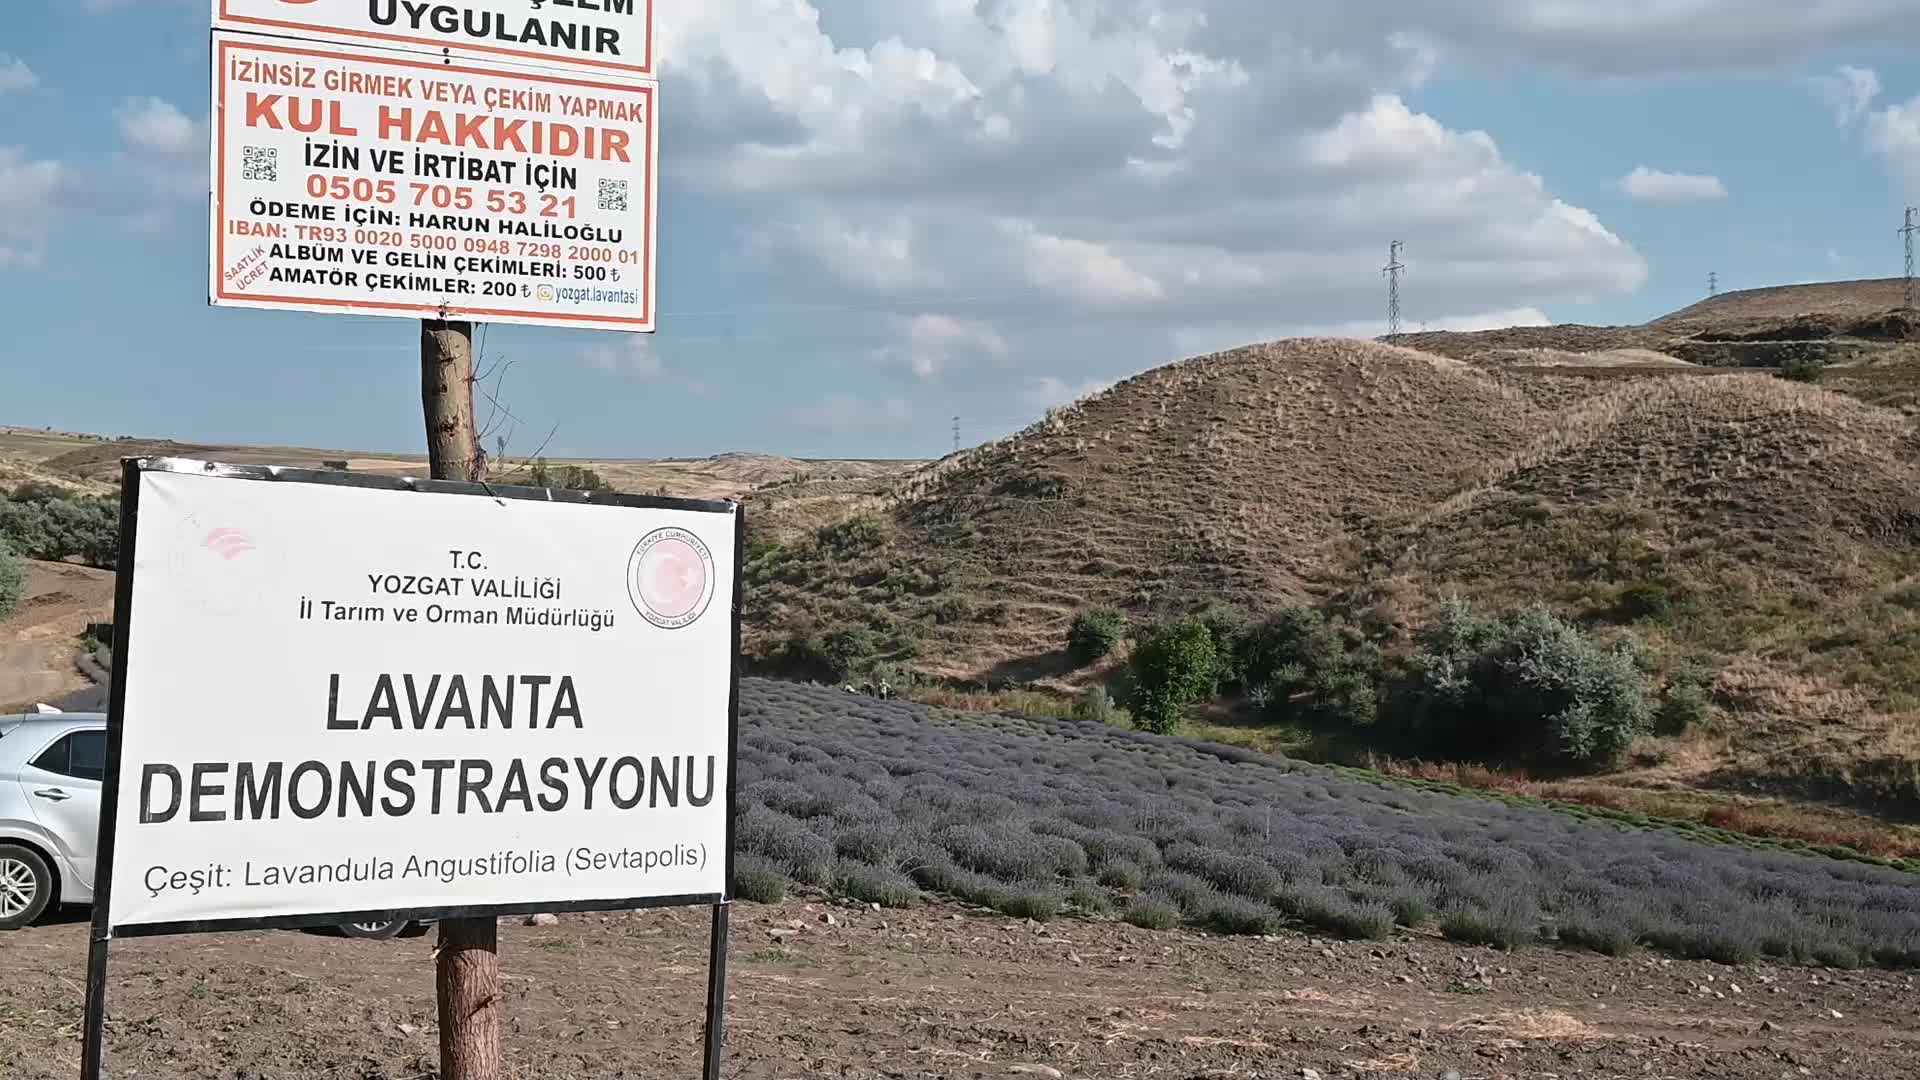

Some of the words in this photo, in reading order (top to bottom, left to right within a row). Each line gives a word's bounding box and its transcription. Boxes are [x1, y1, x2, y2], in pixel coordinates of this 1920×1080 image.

[369, 0, 620, 55] UYGULANIR
[232, 55, 315, 88] İZİNSİZ
[324, 67, 412, 98] GİRMEK
[420, 80, 476, 105] VEYA
[485, 87, 550, 113] ÇEKİM
[559, 95, 642, 123] YAPMAK
[246, 92, 357, 136] KUL
[379, 105, 630, 162] HAKKIDIR
[305, 137, 359, 170] İZİN
[370, 149, 404, 174] VE
[415, 147, 516, 184] İRTİBAT
[526, 157, 576, 193] İÇİN
[307, 174, 395, 203] 0505
[410, 183, 472, 209] 705
[487, 190, 526, 214] 53
[540, 195, 575, 218] 21
[230, 220, 286, 238] IBAN:
[295, 225, 346, 245] TR93
[355, 230, 402, 246] 0020
[411, 234, 456, 250] 5000
[464, 238, 509, 254] 0948
[517, 242, 561, 258] 7298
[569, 246, 611, 262] 2000
[619, 250, 636, 264] 01
[250, 197, 335, 221] ÖDEME
[345, 204, 400, 227] İÇİN:
[410, 213, 489, 232] HARUN
[499, 220, 622, 243] HALİLOĞLU
[269, 243, 343, 262] ALBÜM
[351, 249, 377, 265] VE
[386, 251, 446, 269] GELİN
[454, 256, 566, 278] ÇEKİMLERİ:
[574, 265, 605, 281] 500
[269, 267, 358, 286] AMATÖR
[366, 273, 475, 294] ÇEKİMLER:
[482, 281, 516, 296] 200
[556, 286, 638, 305] yozgat.lavantasi
[449, 550, 487, 569] T.C.
[368, 574, 464, 596] YOZGAT
[471, 576, 560, 599] VALİLİĞİ
[321, 601, 384, 621] Tarım
[393, 608, 417, 622] ve
[426, 604, 497, 624] Orman
[507, 607, 614, 631] Müdürlüğü
[327, 674, 583, 730] LAVANTA
[139, 756, 715, 824] DEMONSTRASYONU
[144, 864, 231, 898] Çeşit:
[245, 857, 393, 886] Lavandula
[402, 850, 555, 883] Angustifolia
[566, 843, 706, 876] (Sevtapolis)
